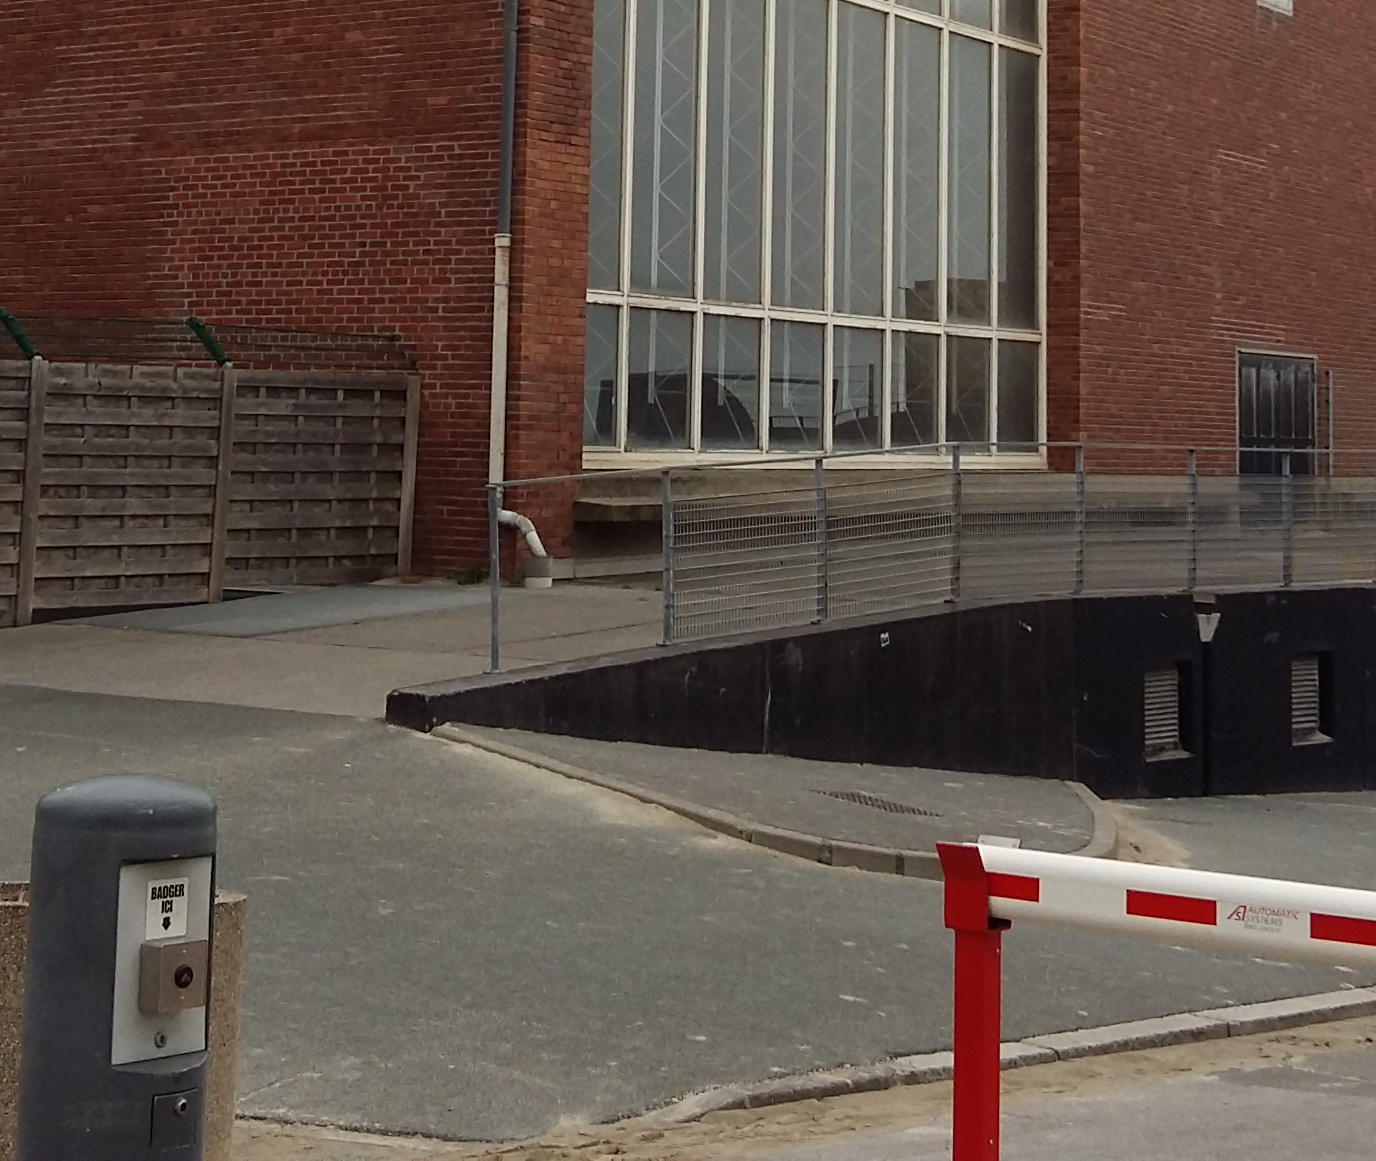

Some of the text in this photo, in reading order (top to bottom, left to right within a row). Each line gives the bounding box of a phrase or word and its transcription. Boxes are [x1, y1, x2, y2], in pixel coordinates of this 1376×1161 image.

[151, 884, 185, 900] BADGER
[161, 899, 173, 914] ICI
[1247, 906, 1300, 920] AUTOMATIC
[1245, 914, 1283, 926] SYSTEMS
